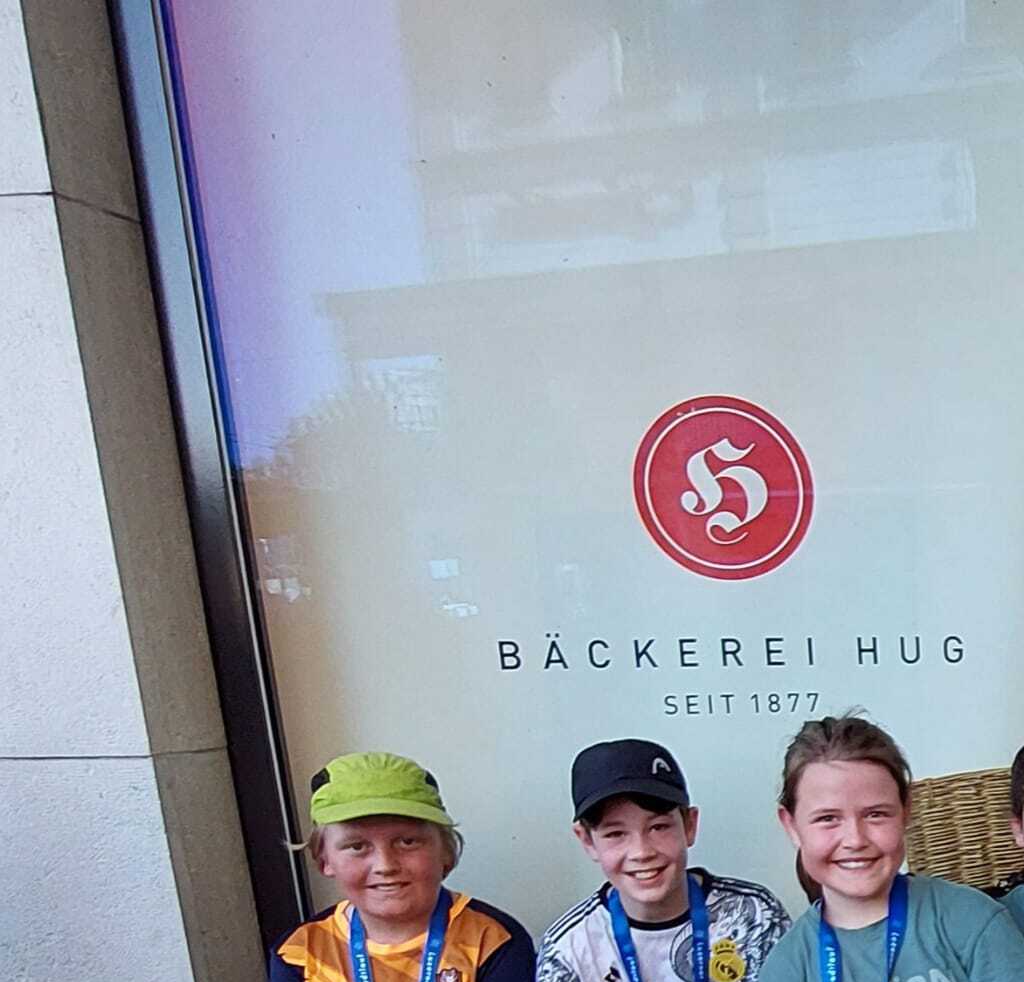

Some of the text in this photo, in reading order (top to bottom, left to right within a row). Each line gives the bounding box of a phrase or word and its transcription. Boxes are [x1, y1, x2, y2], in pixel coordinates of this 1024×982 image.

[498, 633, 965, 670] BÄCKEREI HUG
[664, 692, 821, 715] SEIT 1877
